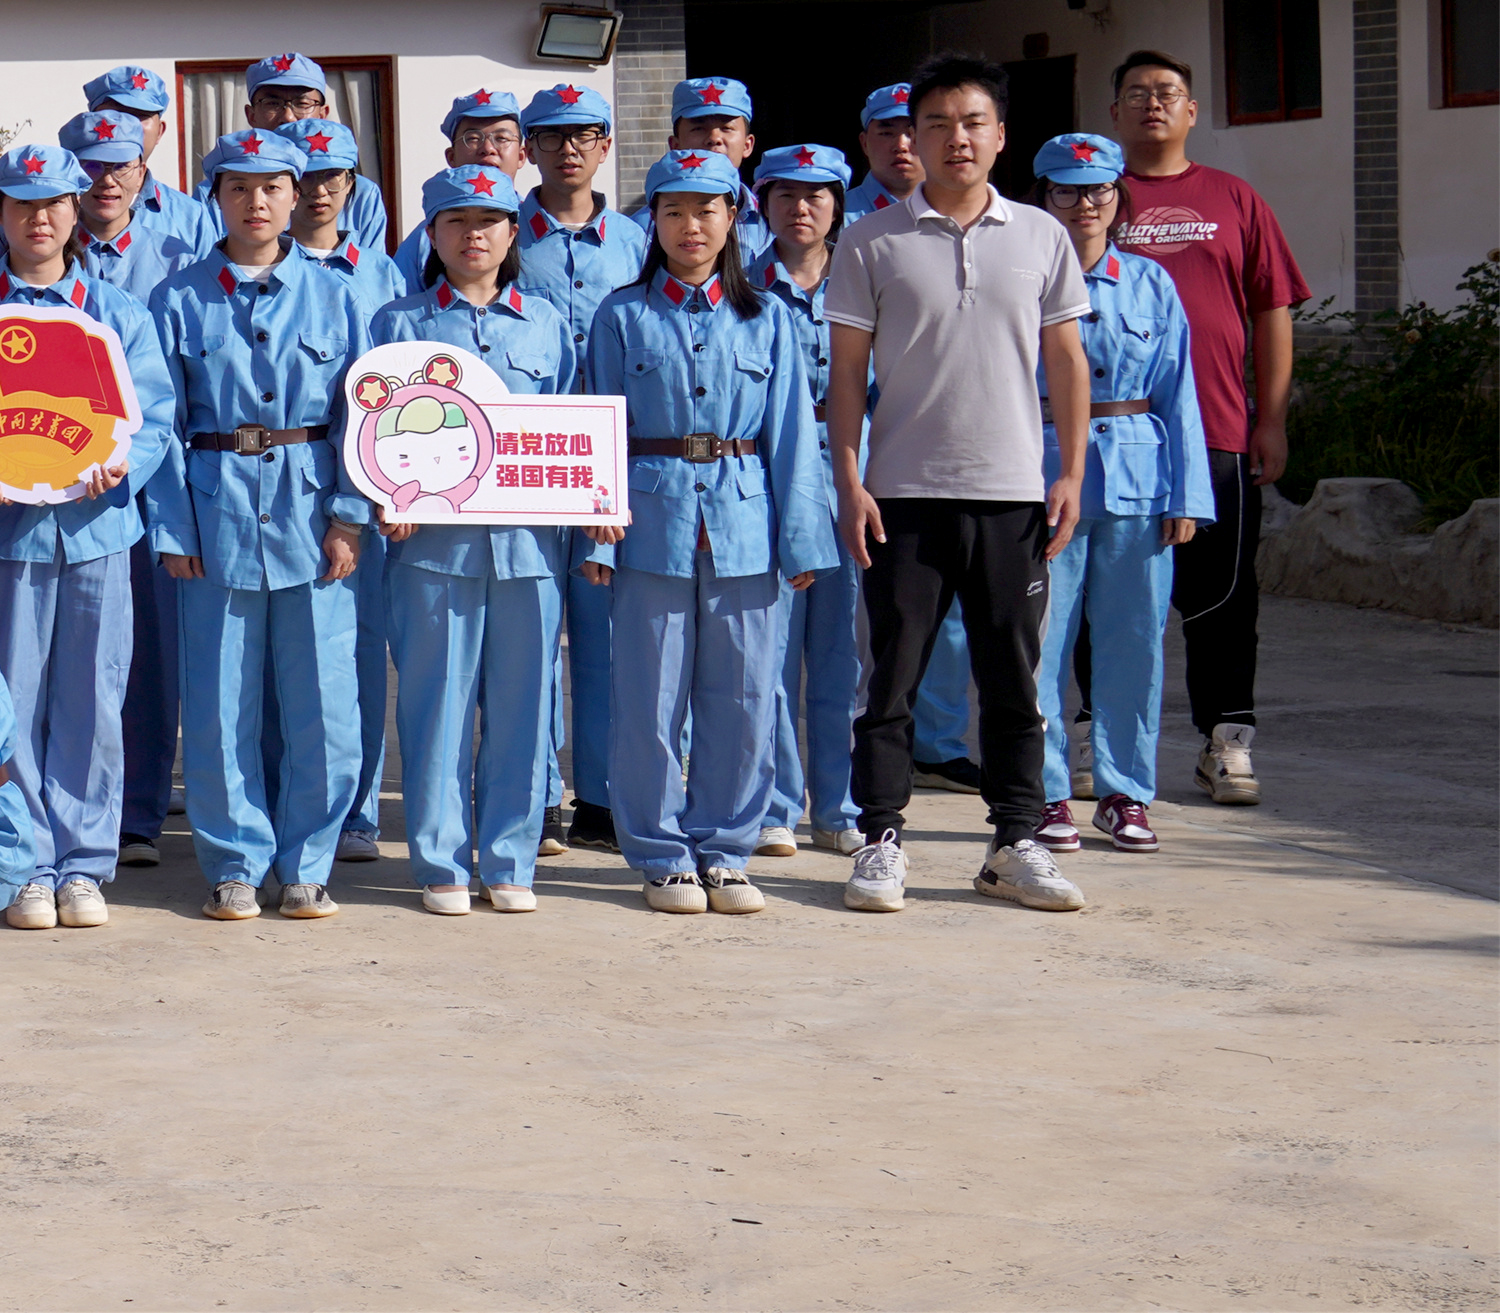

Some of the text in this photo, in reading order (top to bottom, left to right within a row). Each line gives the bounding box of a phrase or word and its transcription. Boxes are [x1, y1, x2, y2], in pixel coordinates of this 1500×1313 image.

[1155, 233, 1206, 244] ORIGINAL
[495, 432, 593, 456] 请党放心
[495, 464, 593, 489] 强国有我
